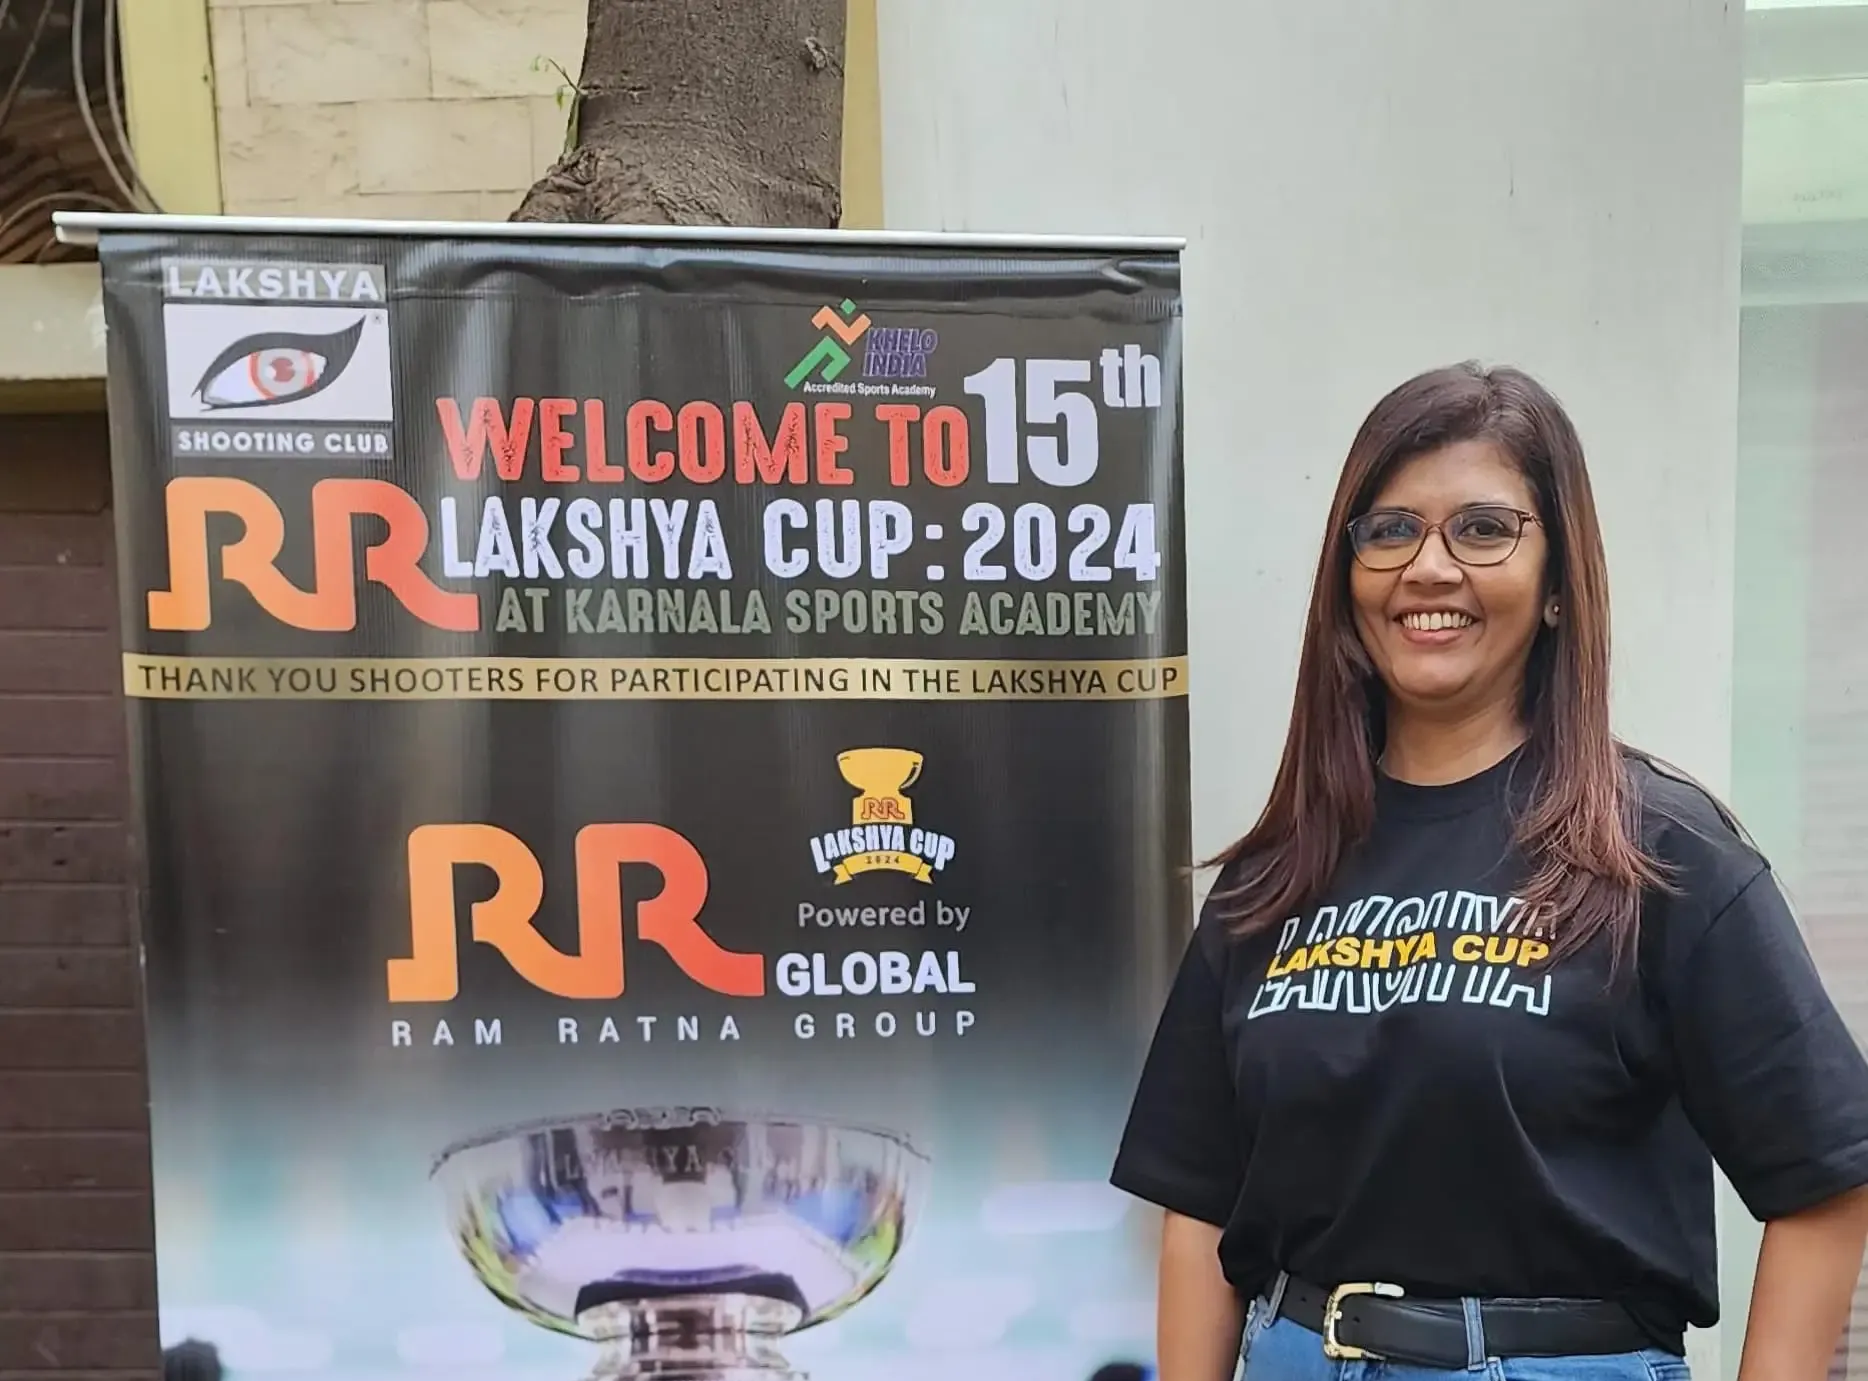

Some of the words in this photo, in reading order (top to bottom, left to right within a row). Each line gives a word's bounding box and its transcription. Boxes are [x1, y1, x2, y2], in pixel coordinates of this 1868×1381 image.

[170, 266, 379, 300] LAKSHYA
[867, 327, 938, 353] KHELO
[863, 351, 928, 377] INDIA
[803, 381, 856, 395] Accredited
[858, 383, 889, 397] Sports
[892, 383, 936, 399] Academy
[178, 431, 315, 452] SHOOTING
[324, 433, 388, 453] CLUB
[436, 397, 854, 486] WELCOME
[875, 403, 970, 487] TO
[148, 476, 480, 632] RR
[440, 496, 733, 580] LAKSHYA
[496, 587, 549, 633] AT
[566, 588, 771, 634] KARNALA
[786, 589, 945, 635] SPORTS
[959, 591, 1162, 637] ACADEMY
[137, 665, 257, 692] THANK
[267, 666, 337, 693] YOU
[349, 667, 524, 694] SHOOTERS
[537, 668, 598, 693] FOR
[611, 668, 849, 693] PARTICIPATING
[861, 668, 893, 692] IN
[903, 668, 960, 692] THE
[972, 668, 1107, 694] LAKSHYA
[1117, 667, 1178, 693] CUP
[810, 824, 906, 873] LAKSHYA
[909, 827, 956, 872] CUP
[865, 855, 900, 865] 2024
[387, 823, 765, 1002] RR
[798, 901, 925, 929] Powered
[936, 901, 971, 932] by
[1265, 931, 1437, 979] LAKSHYA
[1451, 934, 1551, 969] CUP
[776, 951, 976, 996] GLOBAL
[391, 1017, 502, 1047] RAM
[558, 1014, 741, 1043] RATNA
[794, 1011, 976, 1039] GROUP
